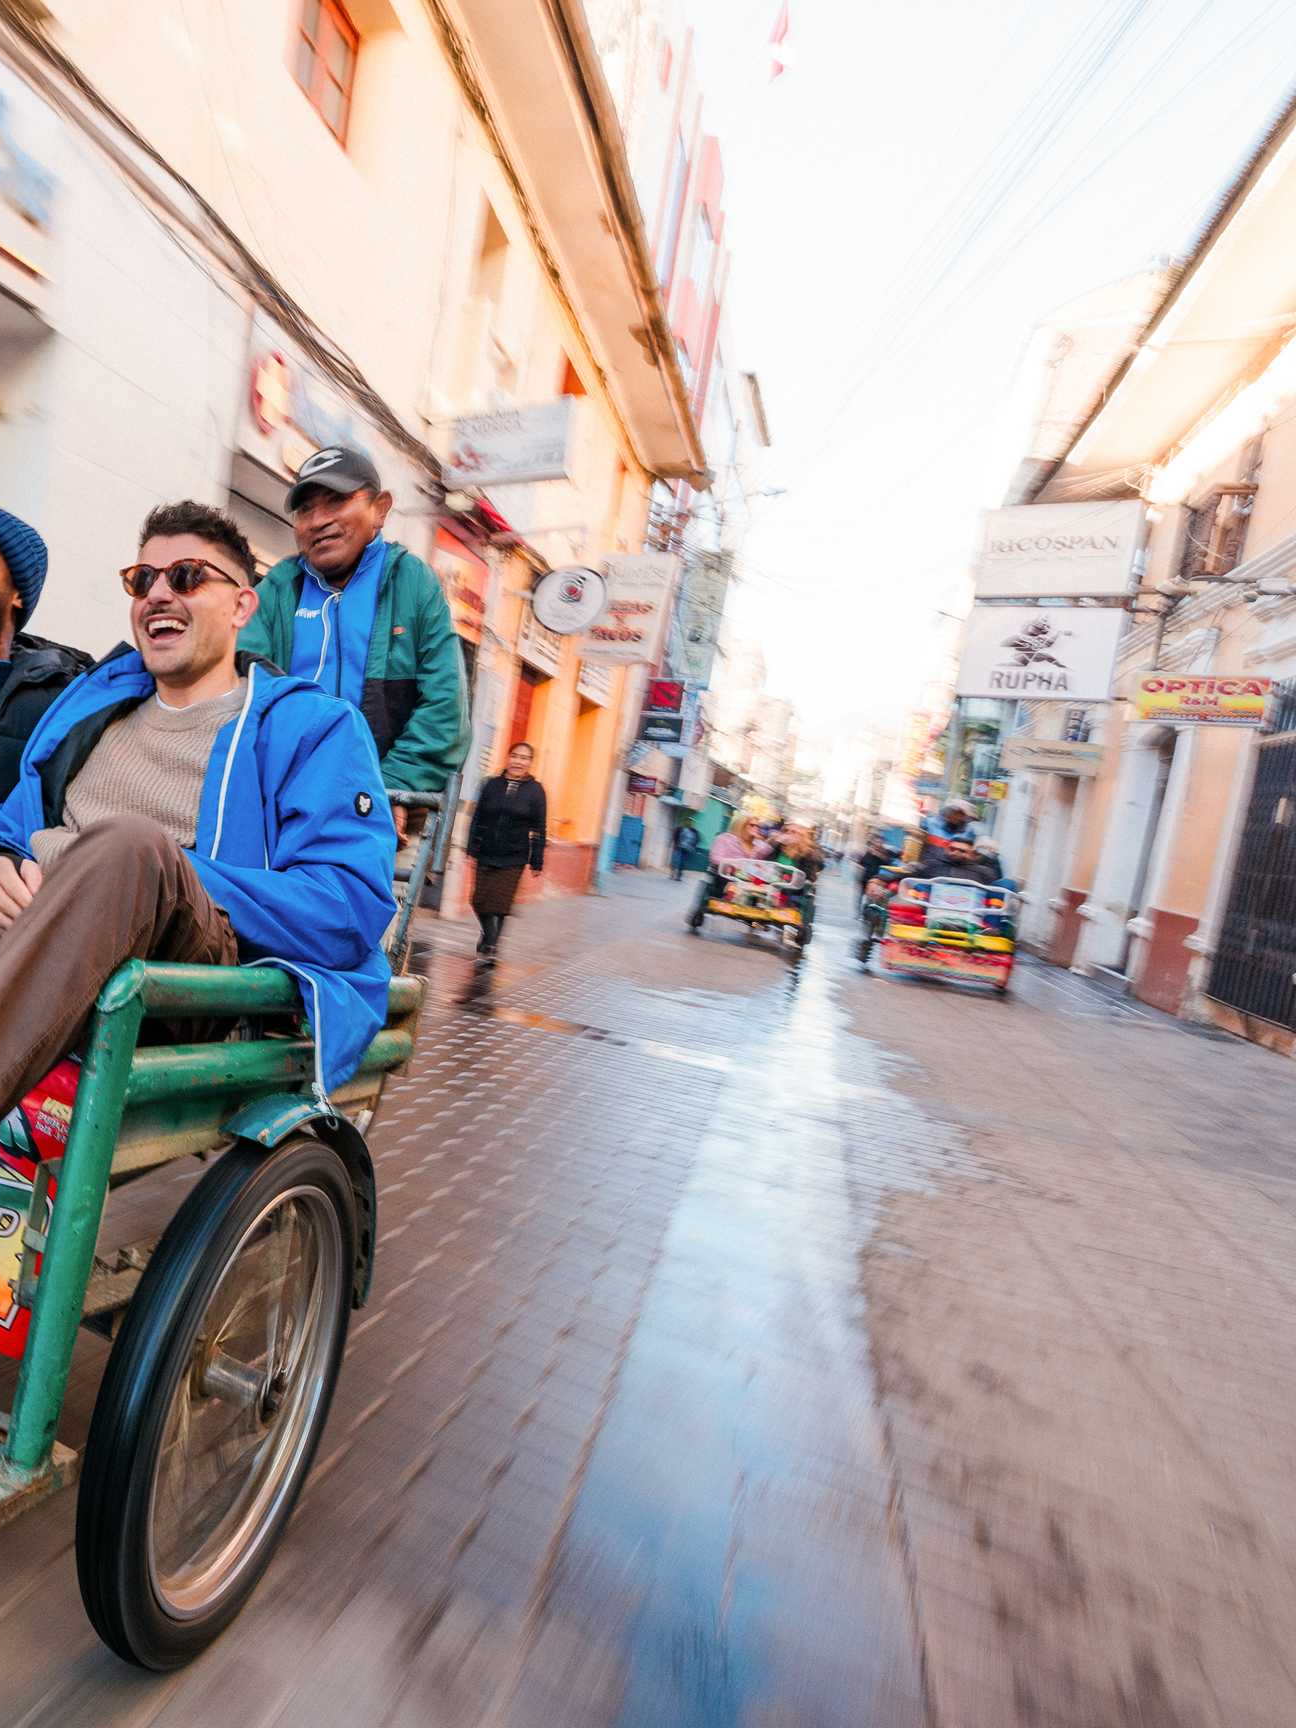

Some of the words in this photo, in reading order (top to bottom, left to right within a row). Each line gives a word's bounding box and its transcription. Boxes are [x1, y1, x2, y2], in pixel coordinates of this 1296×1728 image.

[989, 535, 1121, 554] RICOSPAN
[989, 670, 1070, 691] RUPHA
[1178, 695, 1219, 706] R&M
